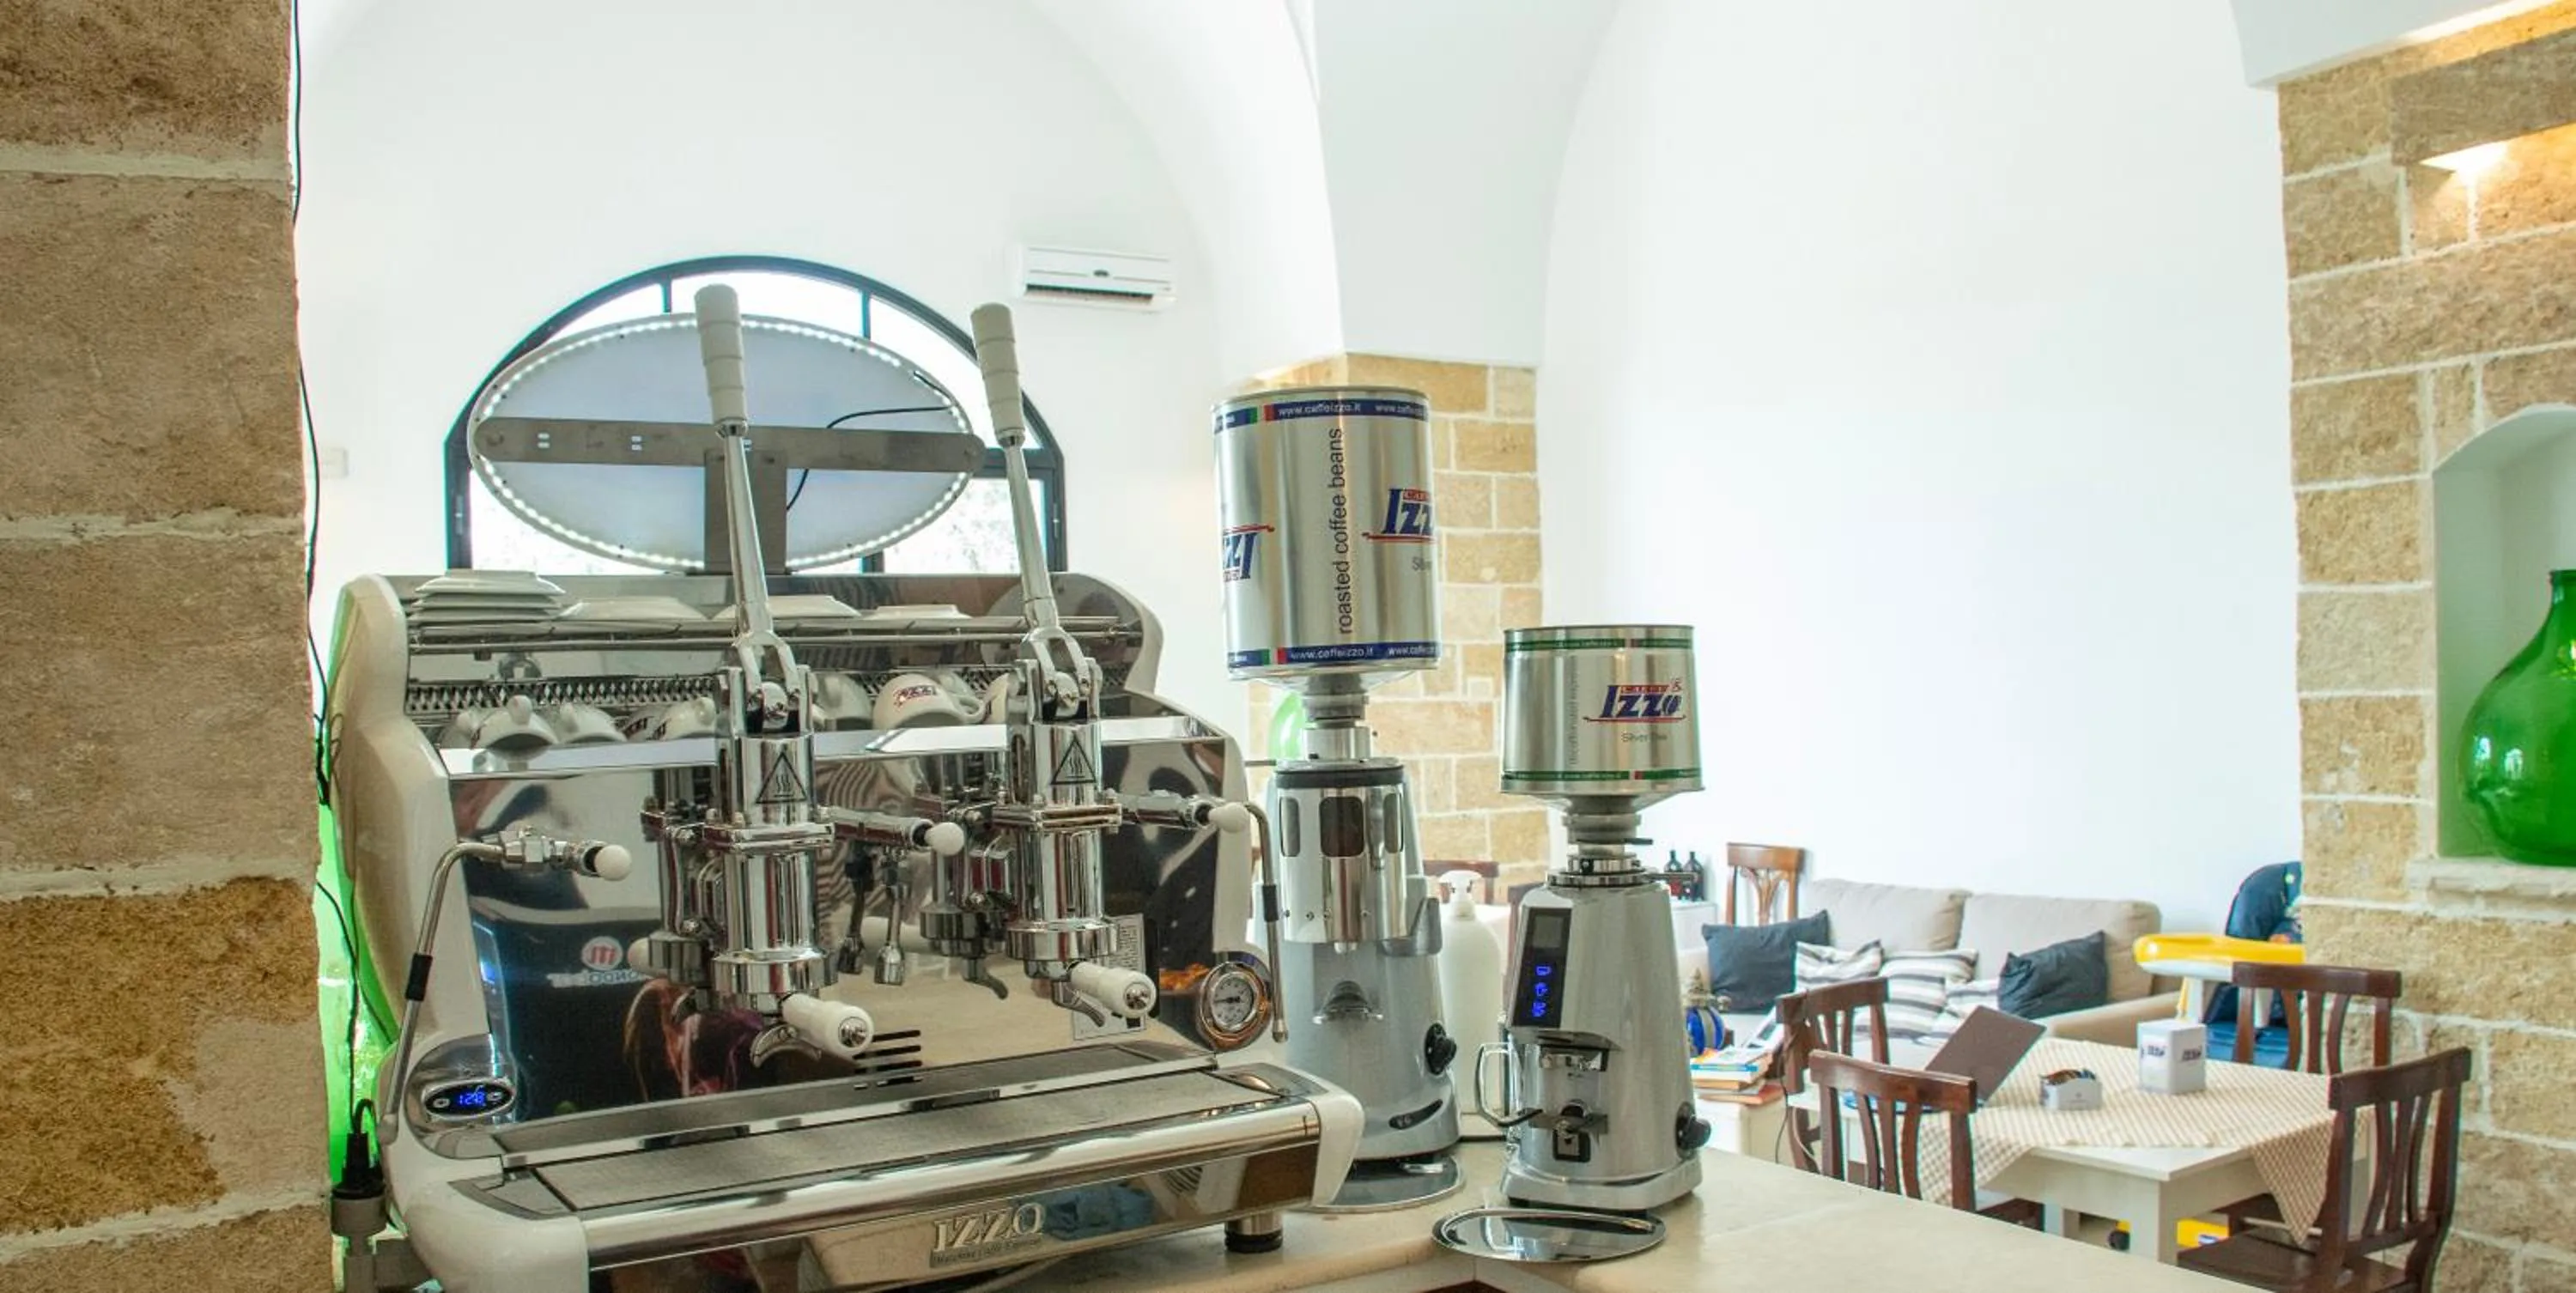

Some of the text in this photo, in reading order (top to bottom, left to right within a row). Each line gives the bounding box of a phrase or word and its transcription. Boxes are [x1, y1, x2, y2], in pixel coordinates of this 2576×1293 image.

[1327, 428, 1352, 634] roasted coffee beans
[933, 1202, 1045, 1253] IZZO
